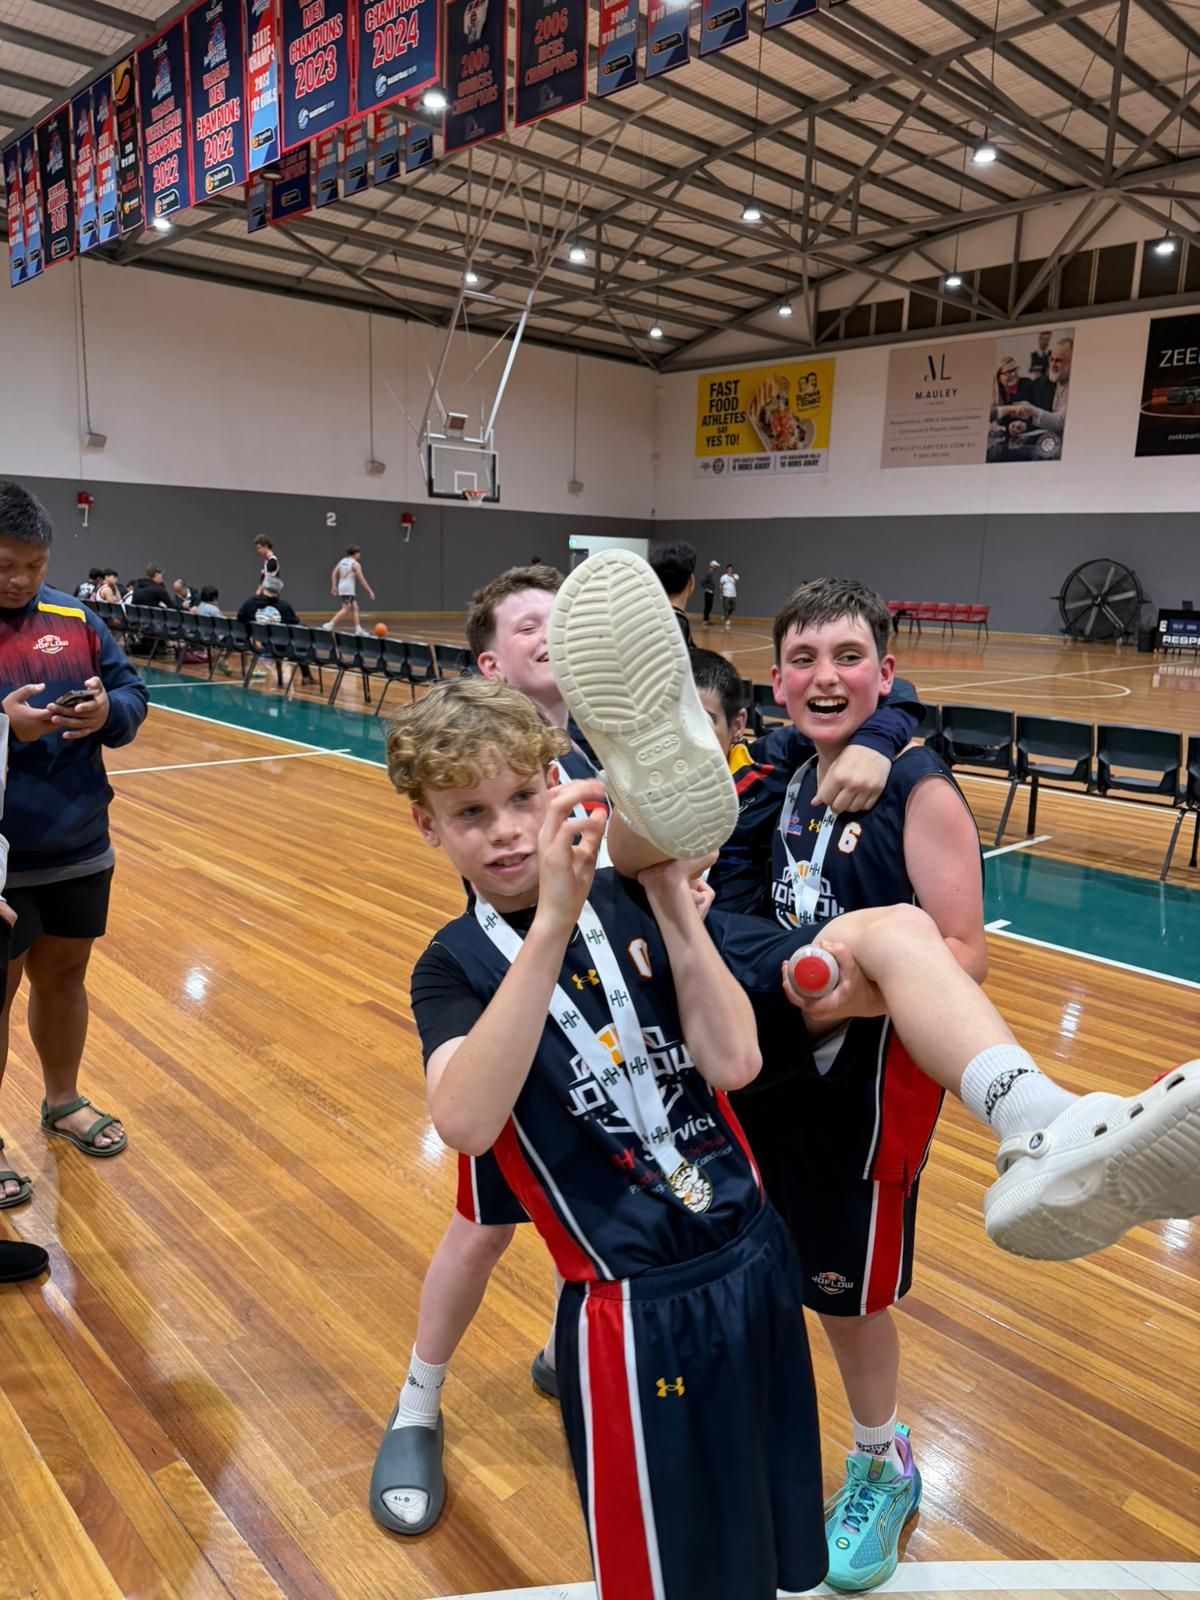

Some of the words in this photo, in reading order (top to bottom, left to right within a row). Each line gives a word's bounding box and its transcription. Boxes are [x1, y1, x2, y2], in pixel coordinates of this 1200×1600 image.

[303, 0, 325, 29] MEN
[365, 0, 425, 32] CHAMPIO
[534, 7, 568, 45] 2006
[252, 25, 271, 52] STATE
[289, 14, 344, 66] CHAMPIONS
[372, 10, 420, 69] 2024
[295, 45, 338, 99] 2023
[460, 44, 490, 78] 2006
[196, 96, 240, 141] CHAMPIONS
[147, 127, 182, 165] CHAMPIONS
[204, 126, 234, 169] 2022
[152, 154, 180, 193] 2022
[1160, 347, 1200, 368] ZEE
[710, 378, 740, 398] FAST
[702, 412, 746, 427] ATHLETES
[708, 397, 738, 414] FOOD
[706, 435, 722, 448] YES
[725, 434, 740, 446] TO!
[326, 512, 336, 526] 2
[640, 735, 679, 761] crocs
[838, 821, 862, 854] 6
[811, 1276, 854, 1288] JOFLOW
